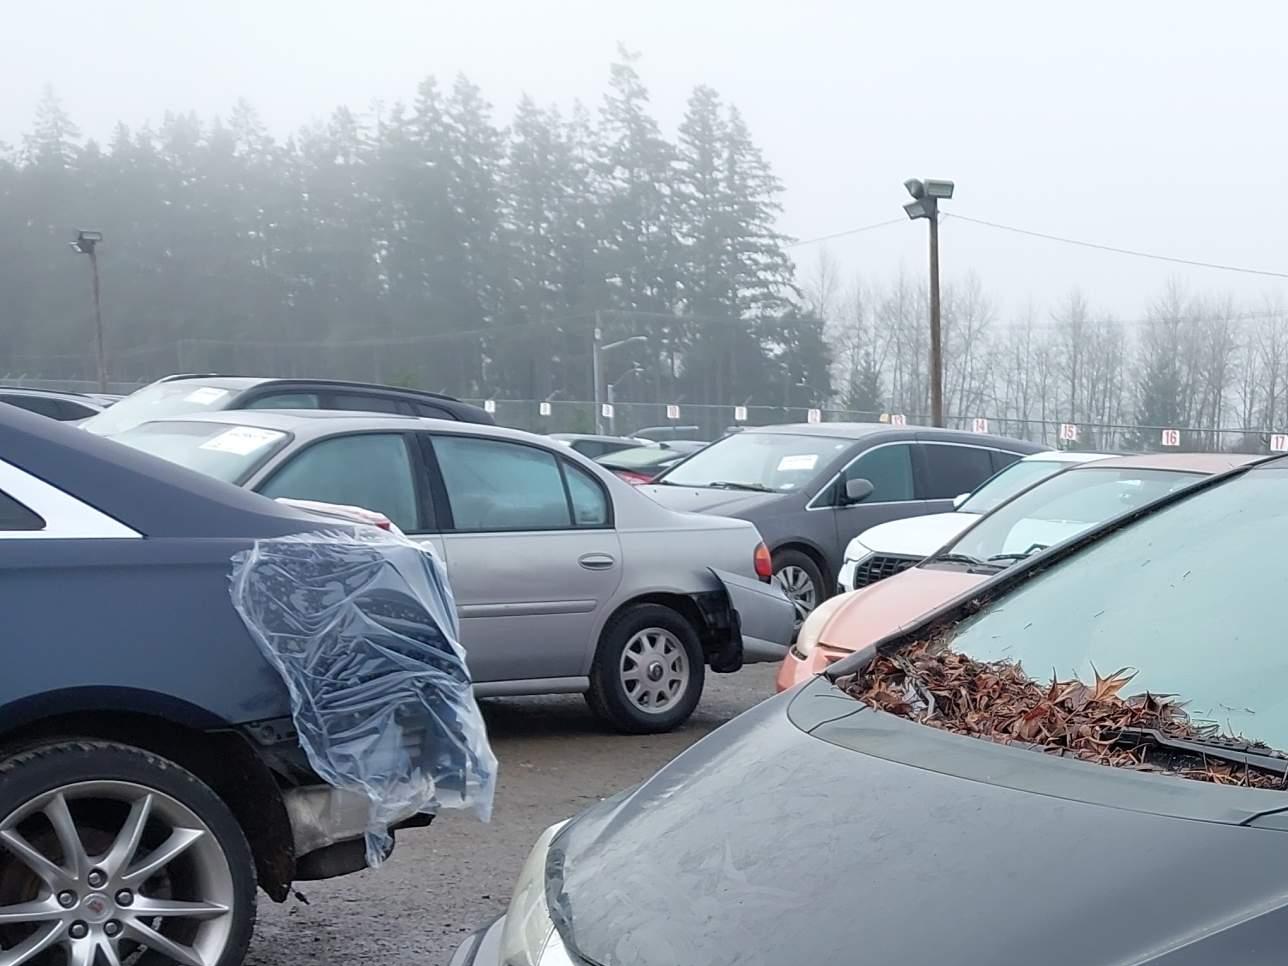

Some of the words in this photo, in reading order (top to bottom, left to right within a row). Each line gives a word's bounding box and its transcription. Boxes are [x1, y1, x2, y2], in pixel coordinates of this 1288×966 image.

[1063, 425, 1075, 439] 15
[1165, 431, 1177, 445] 16
[1274, 436, 1286, 450] 17
